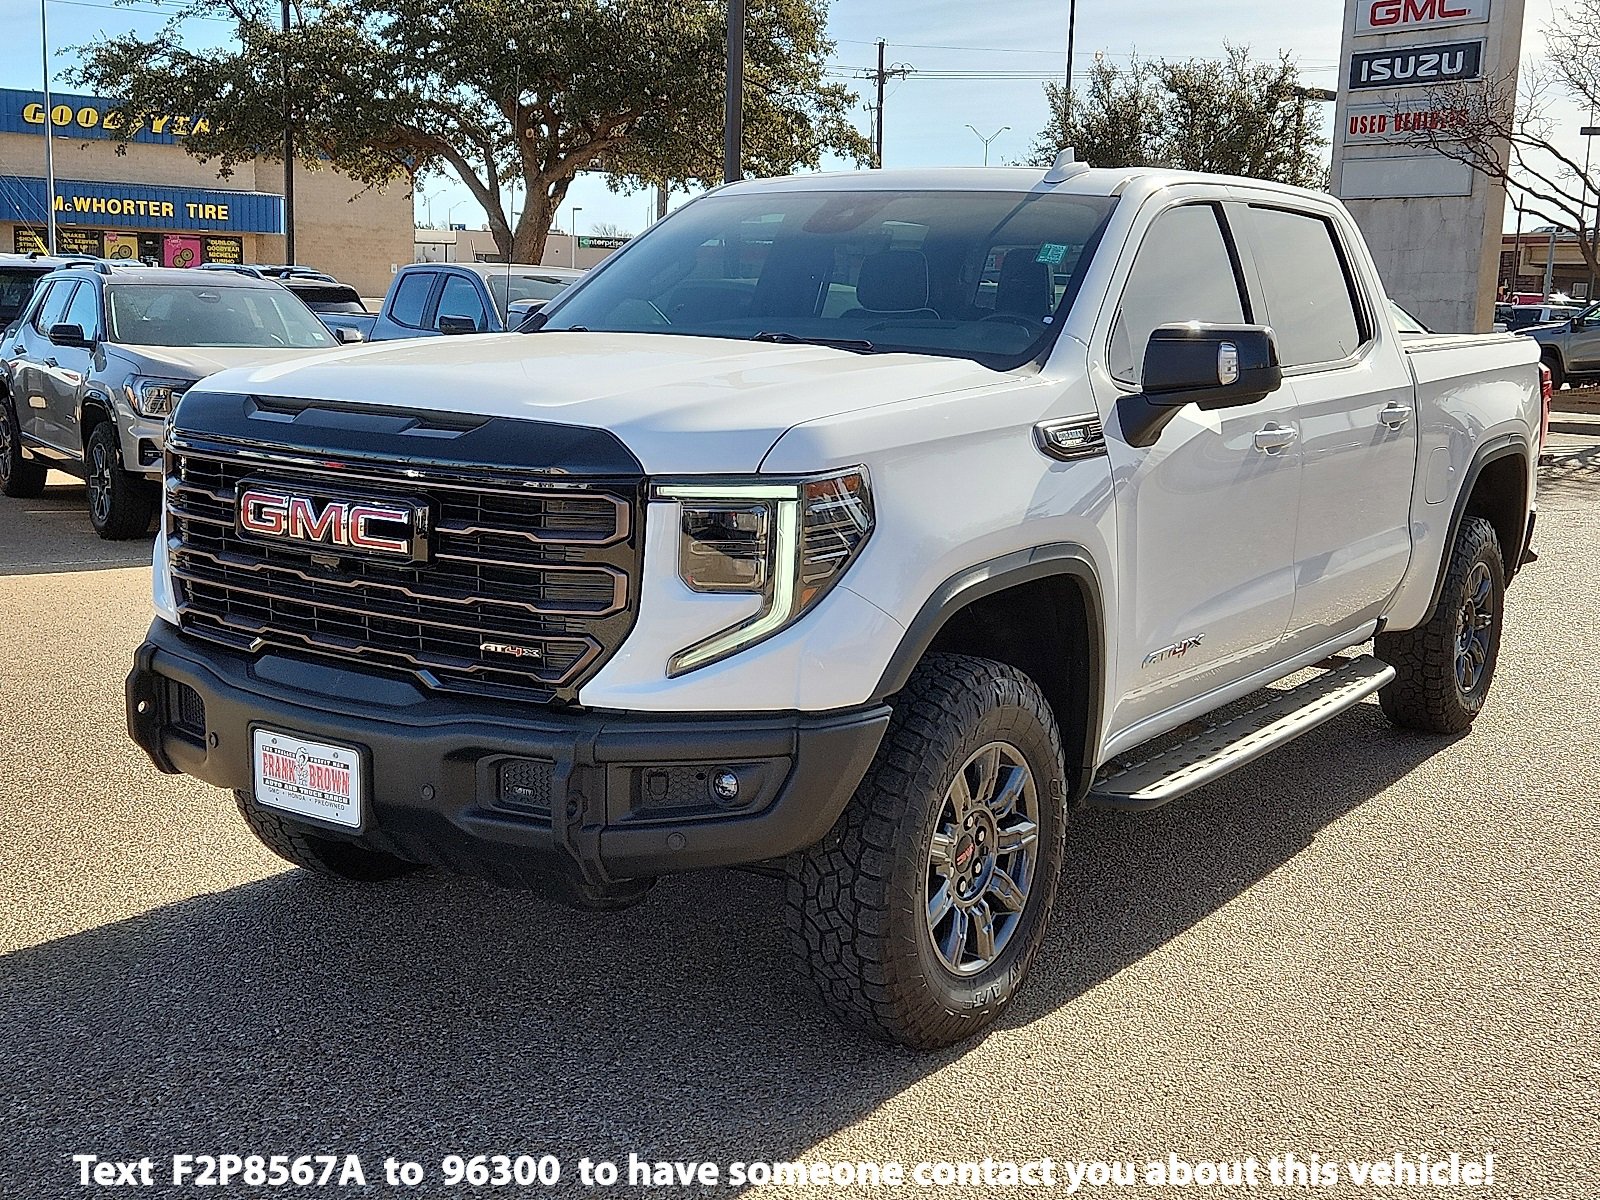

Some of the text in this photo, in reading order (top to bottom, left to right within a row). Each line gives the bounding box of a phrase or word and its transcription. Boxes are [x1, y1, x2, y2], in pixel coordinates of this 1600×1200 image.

[1370, 0, 1467, 27] GMC
[1360, 51, 1465, 82] ISUZU
[1350, 114, 1386, 134] USED
[186, 203, 229, 220] TIRE
[580, 238, 624, 248] enterprise
[240, 490, 411, 555] GMC
[263, 753, 350, 796] FRANK BROWN
[265, 779, 283, 788] AUTO
[299, 788, 323, 798] TRUCK
[324, 794, 349, 804] RANCH
